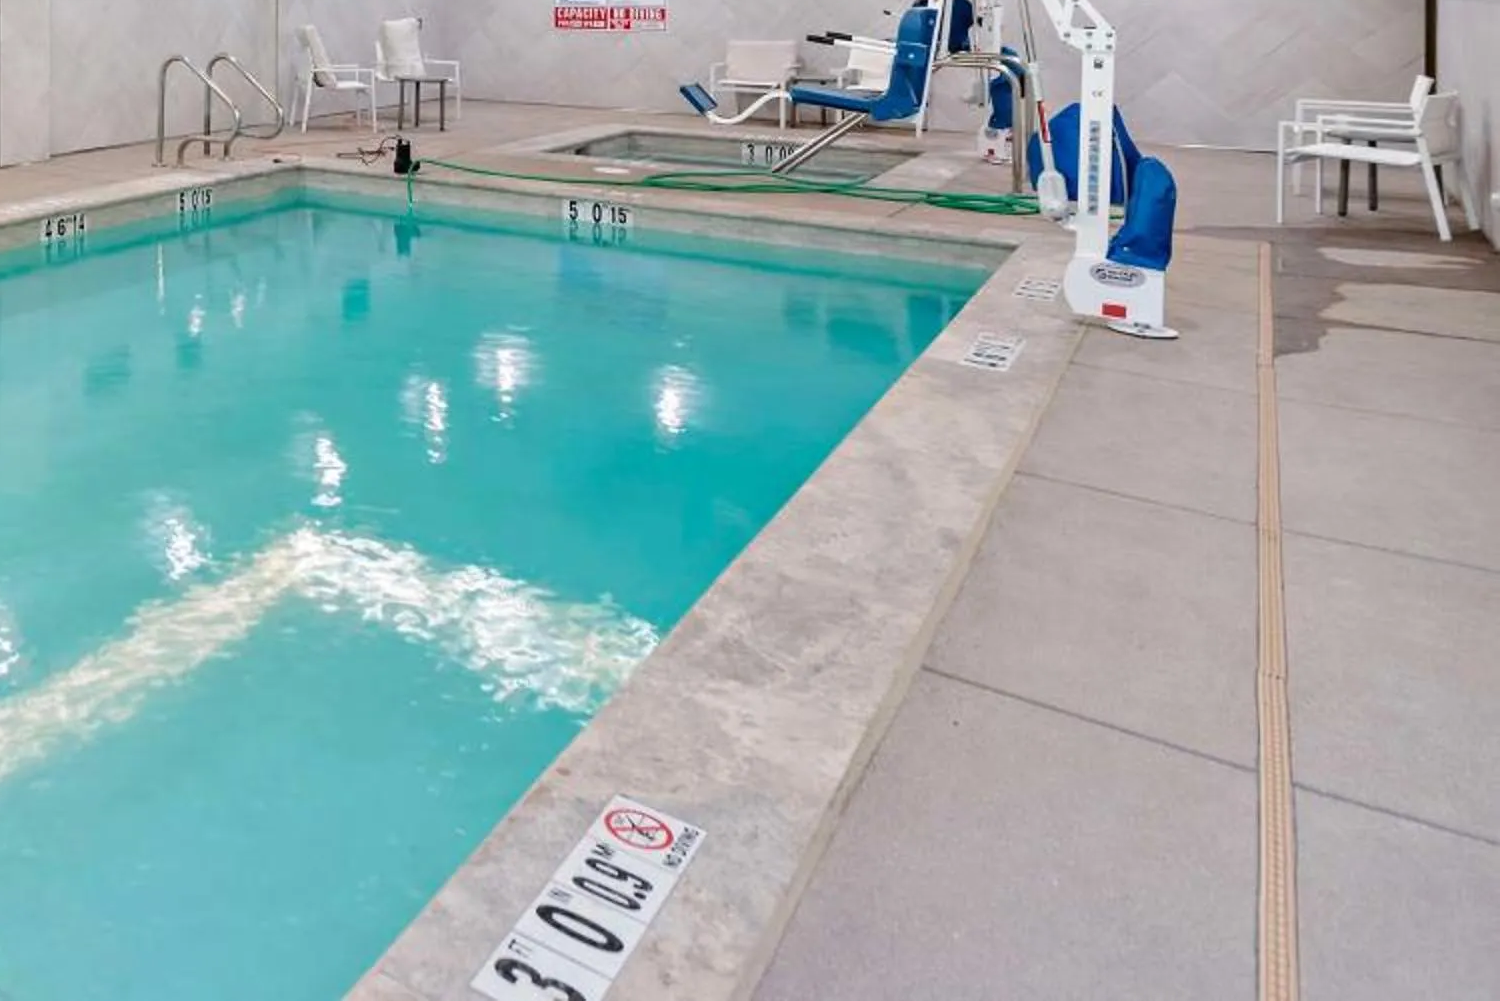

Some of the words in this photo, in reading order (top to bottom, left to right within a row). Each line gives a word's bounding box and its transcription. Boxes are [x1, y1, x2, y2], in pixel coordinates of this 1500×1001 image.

[57, 218, 67, 236] 6
[569, 200, 578, 221] 5
[592, 203, 602, 224] 0
[535, 904, 625, 954] 0
[494, 958, 587, 1001] 3
